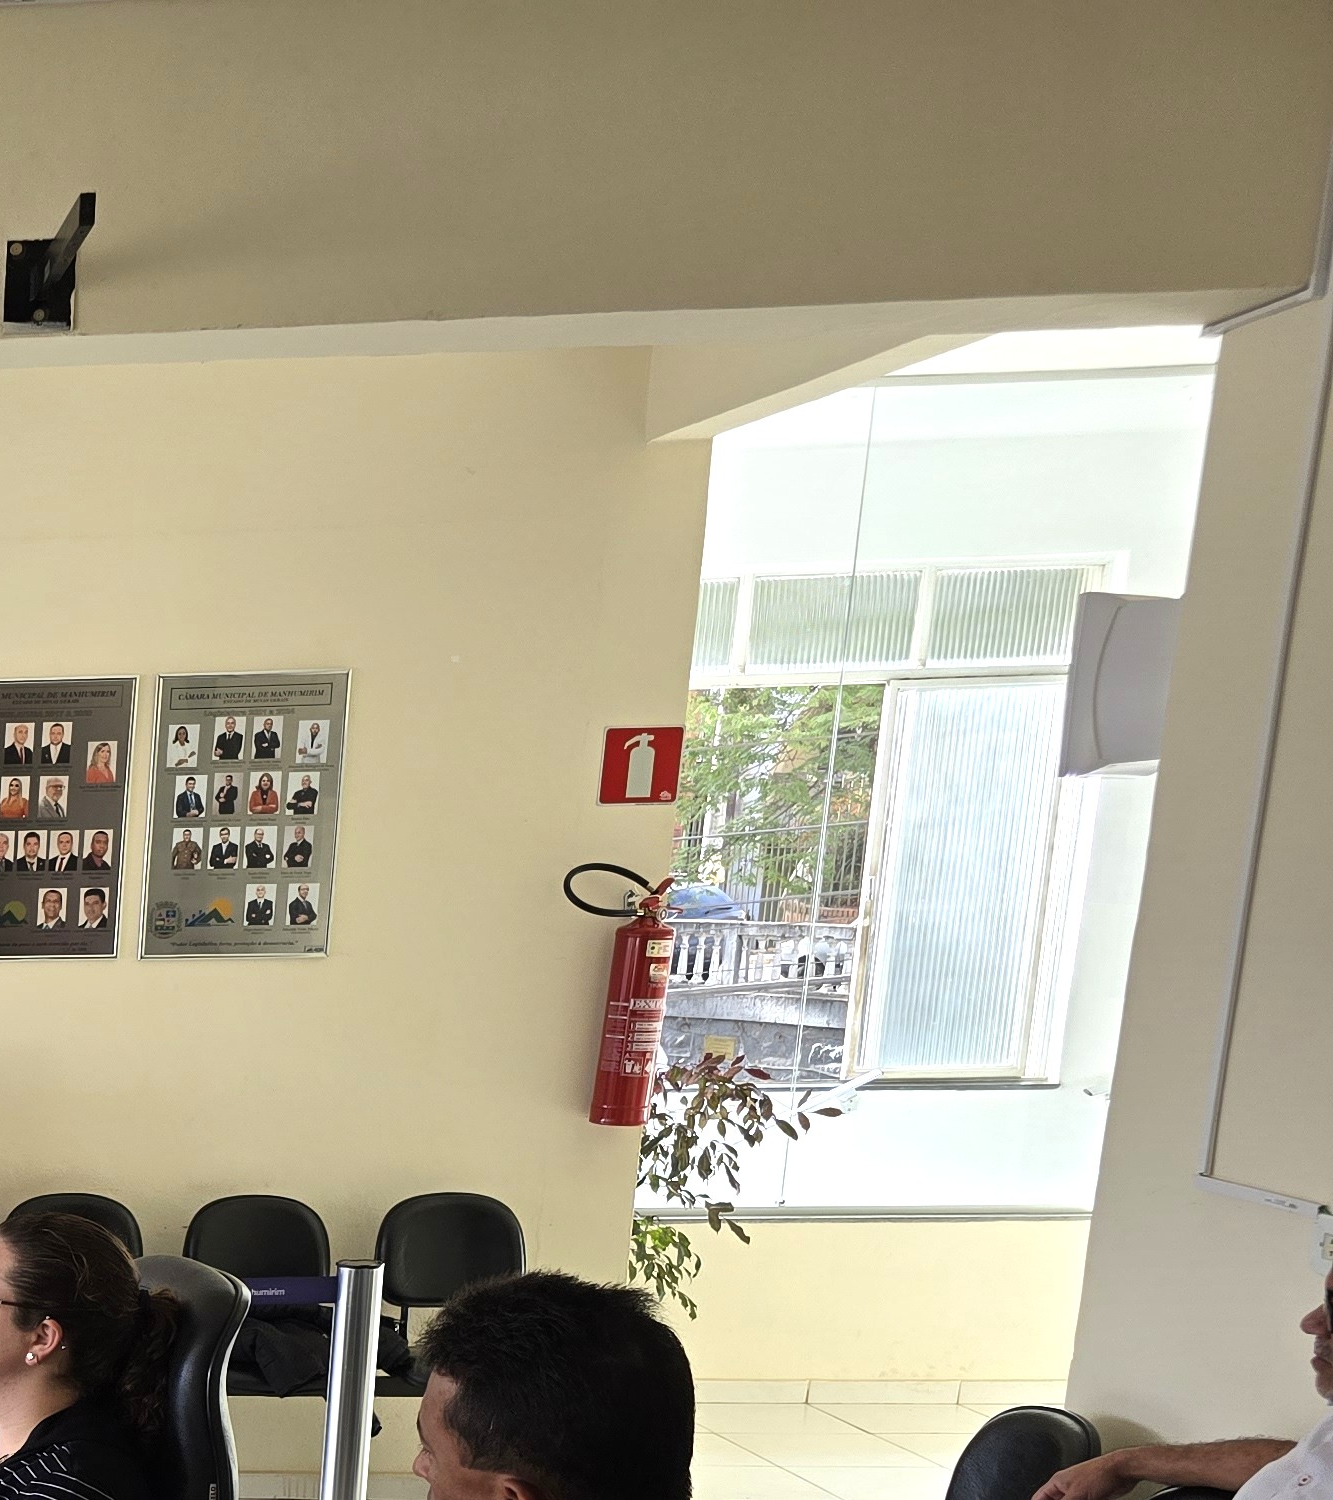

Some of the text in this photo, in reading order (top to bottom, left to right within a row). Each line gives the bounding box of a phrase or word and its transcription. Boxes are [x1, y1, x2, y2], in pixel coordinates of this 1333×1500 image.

[1, 691, 45, 700] MUNICIPAL
[46, 691, 58, 699] DE
[60, 690, 117, 698] MANHUMIRIM
[178, 690, 211, 701] CÂMARA
[211, 691, 256, 700] MUNICIPAL
[270, 689, 325, 698] MANHUMIRIM
[251, 1288, 285, 1296] humirim
